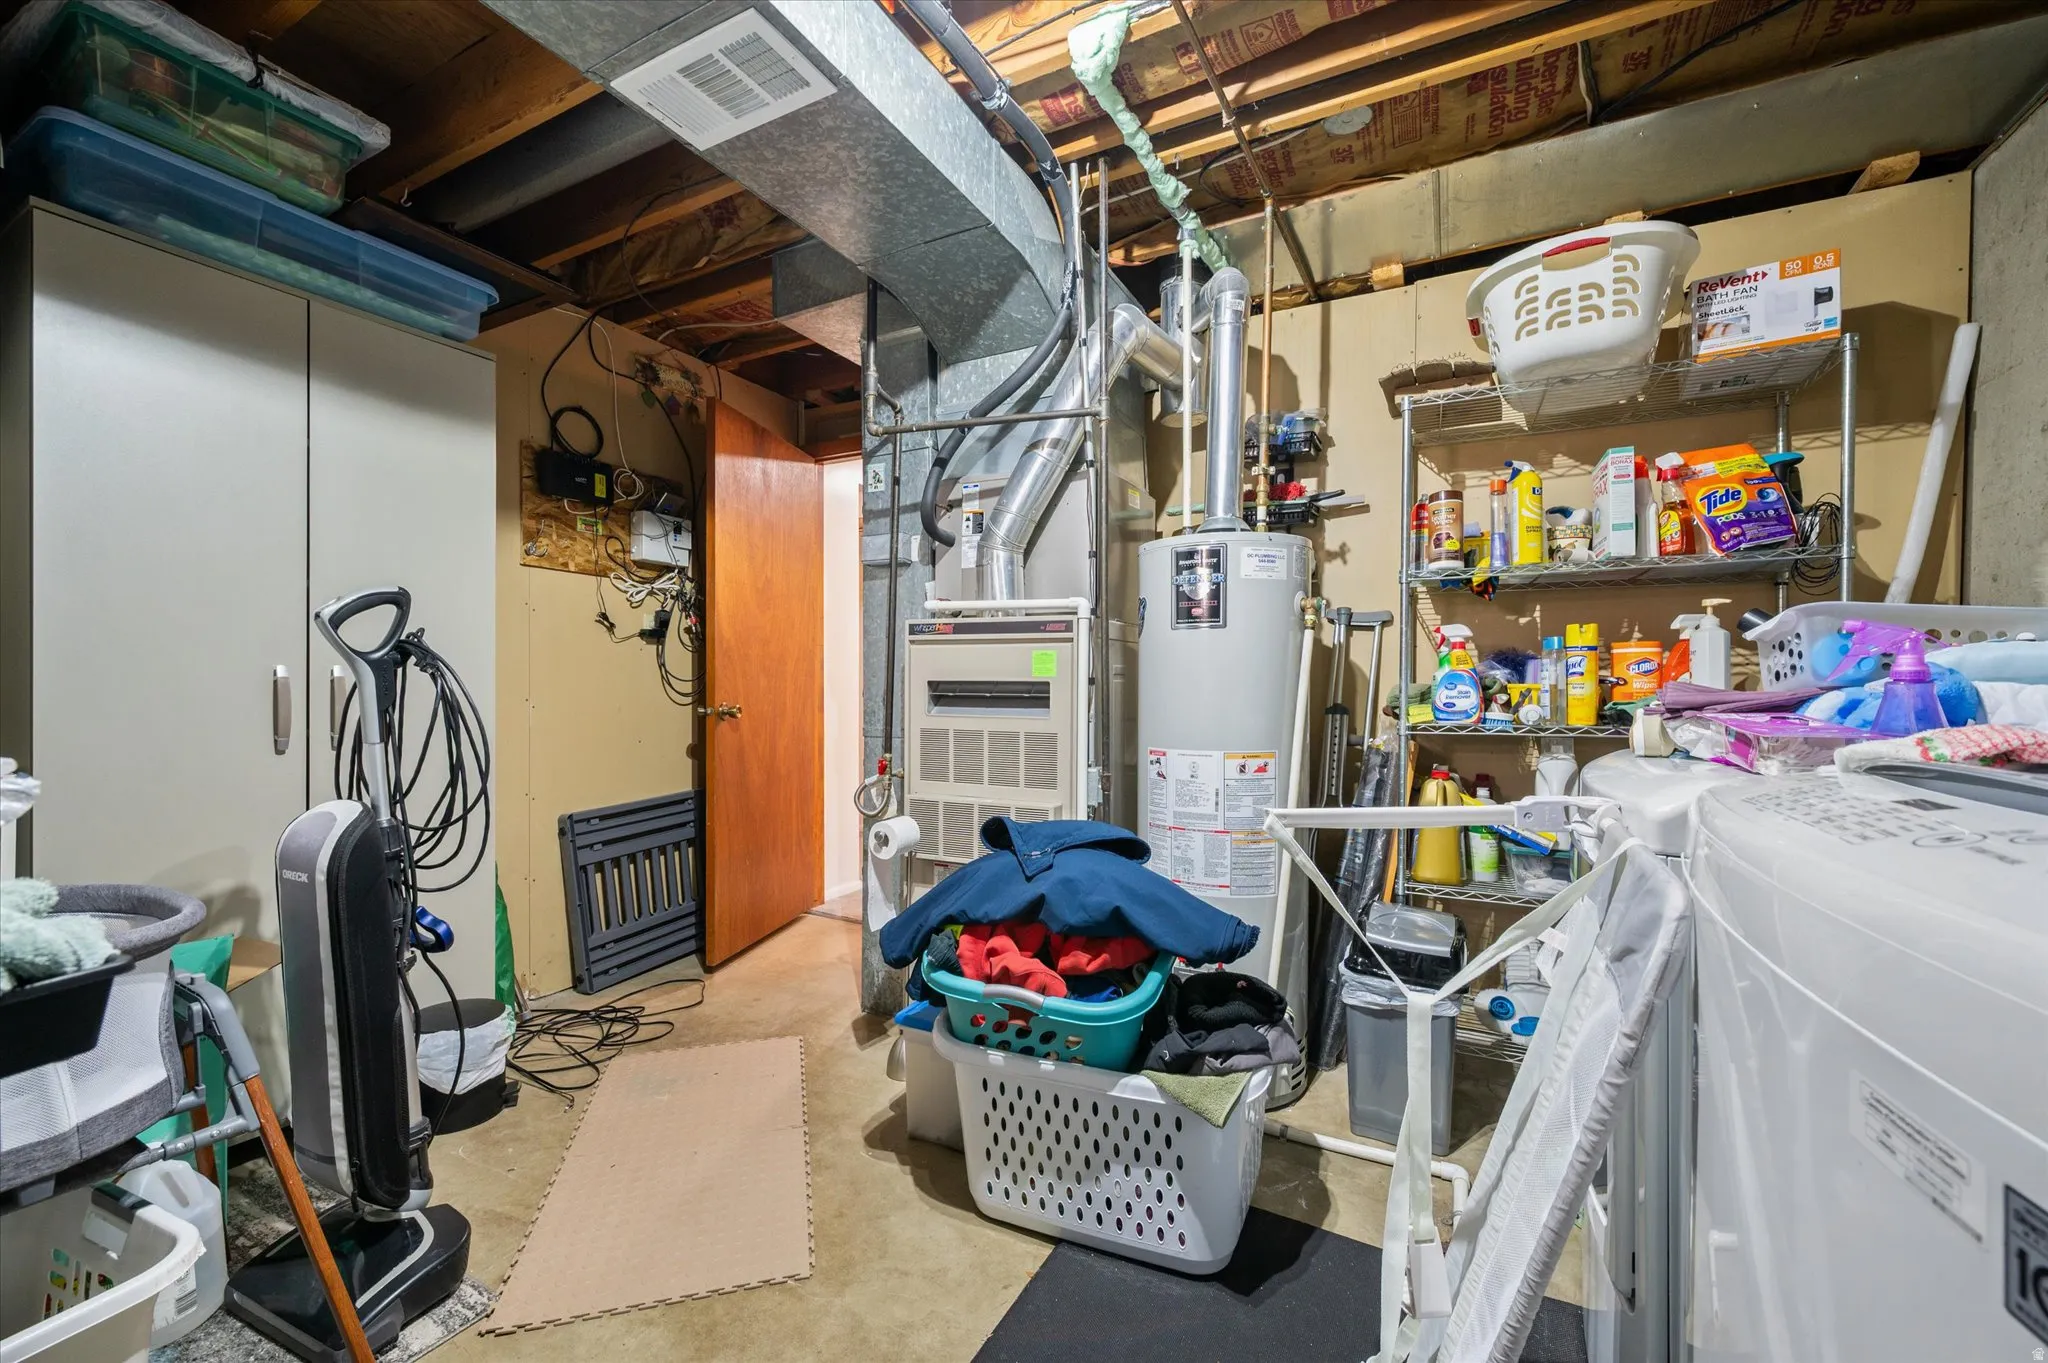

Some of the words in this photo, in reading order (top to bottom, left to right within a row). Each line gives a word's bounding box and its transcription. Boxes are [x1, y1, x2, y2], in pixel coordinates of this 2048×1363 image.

[1507, 57, 1538, 122] uilding
[1488, 64, 1512, 138] sulation
[1785, 260, 1802, 271] 50
[1813, 260, 1834, 271] SONE
[1814, 253, 1834, 265] 0.5
[1785, 269, 1802, 277] CFM
[1697, 270, 1760, 294] ReVent
[1696, 291, 1729, 304] BATH
[1733, 285, 1758, 296] FAN
[1610, 459, 1633, 467] BORAX
[1699, 488, 1742, 515] Tide
[1716, 512, 1746, 526] PODS
[1172, 573, 1225, 585] DEFENDER
[1567, 656, 1585, 671] ysol
[1630, 660, 1659, 674] CLOROX
[1633, 681, 1657, 690] Wipes
[282, 869, 309, 883] ORECK
